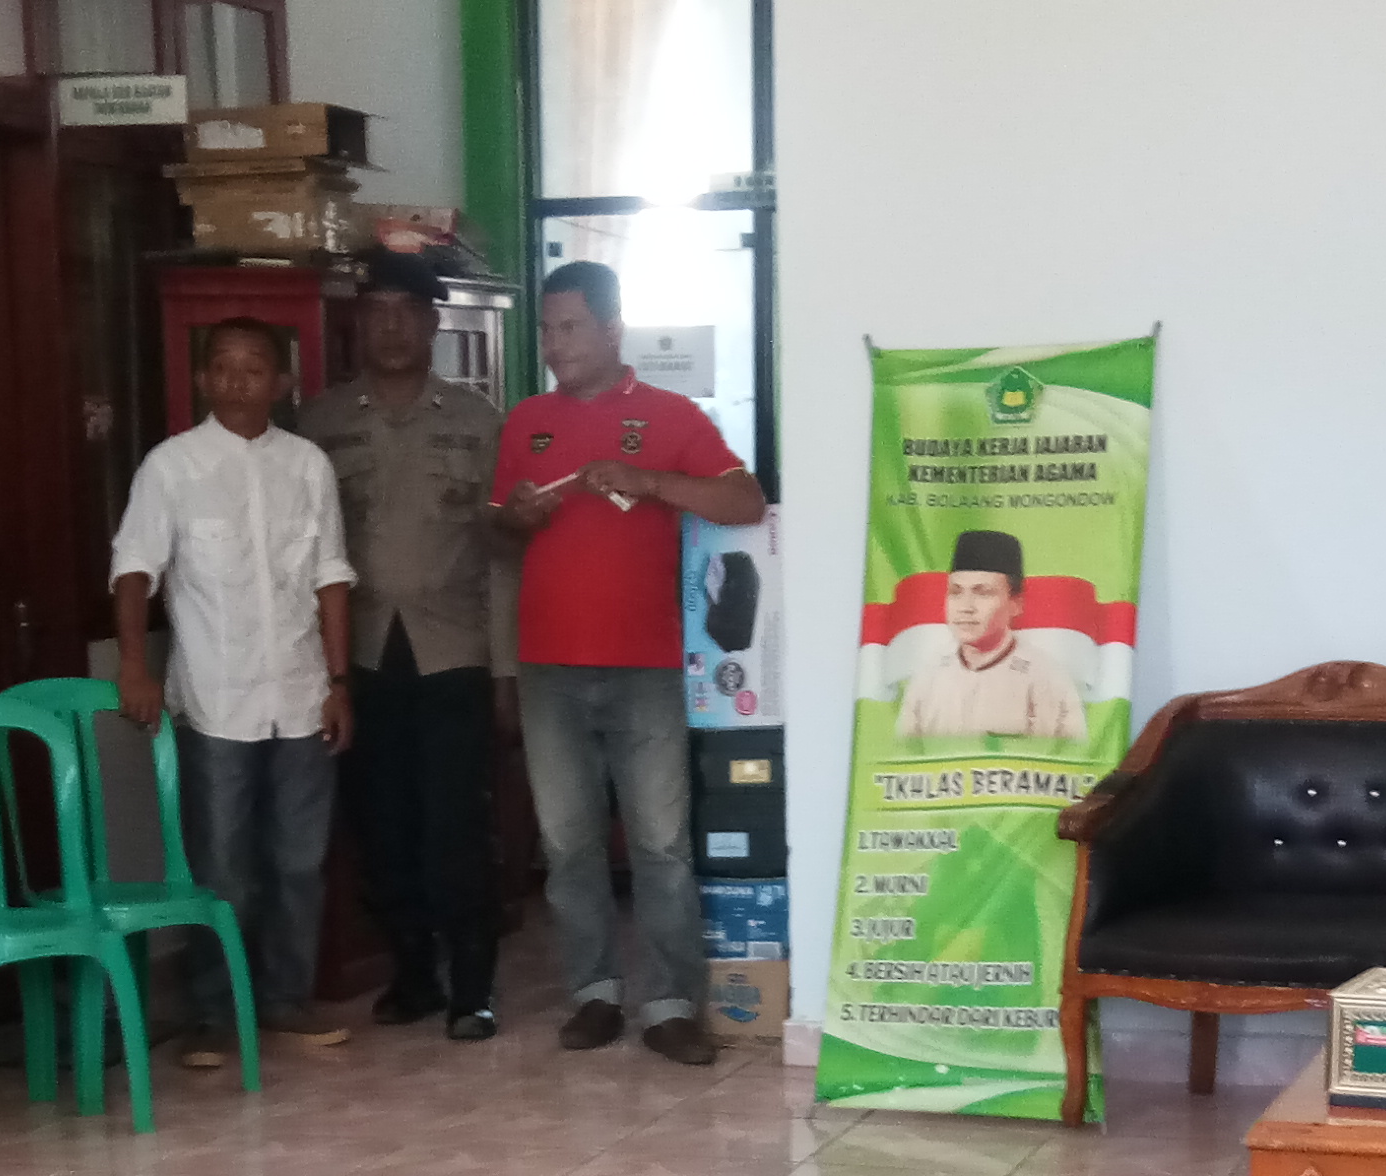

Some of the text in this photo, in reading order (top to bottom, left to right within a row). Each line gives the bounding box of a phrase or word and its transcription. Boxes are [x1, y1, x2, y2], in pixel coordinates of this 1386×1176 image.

[903, 434, 1108, 456] BUDAYA KERJA JAJARAN
[908, 462, 1097, 483] KEMENTERIAN AGAMA
